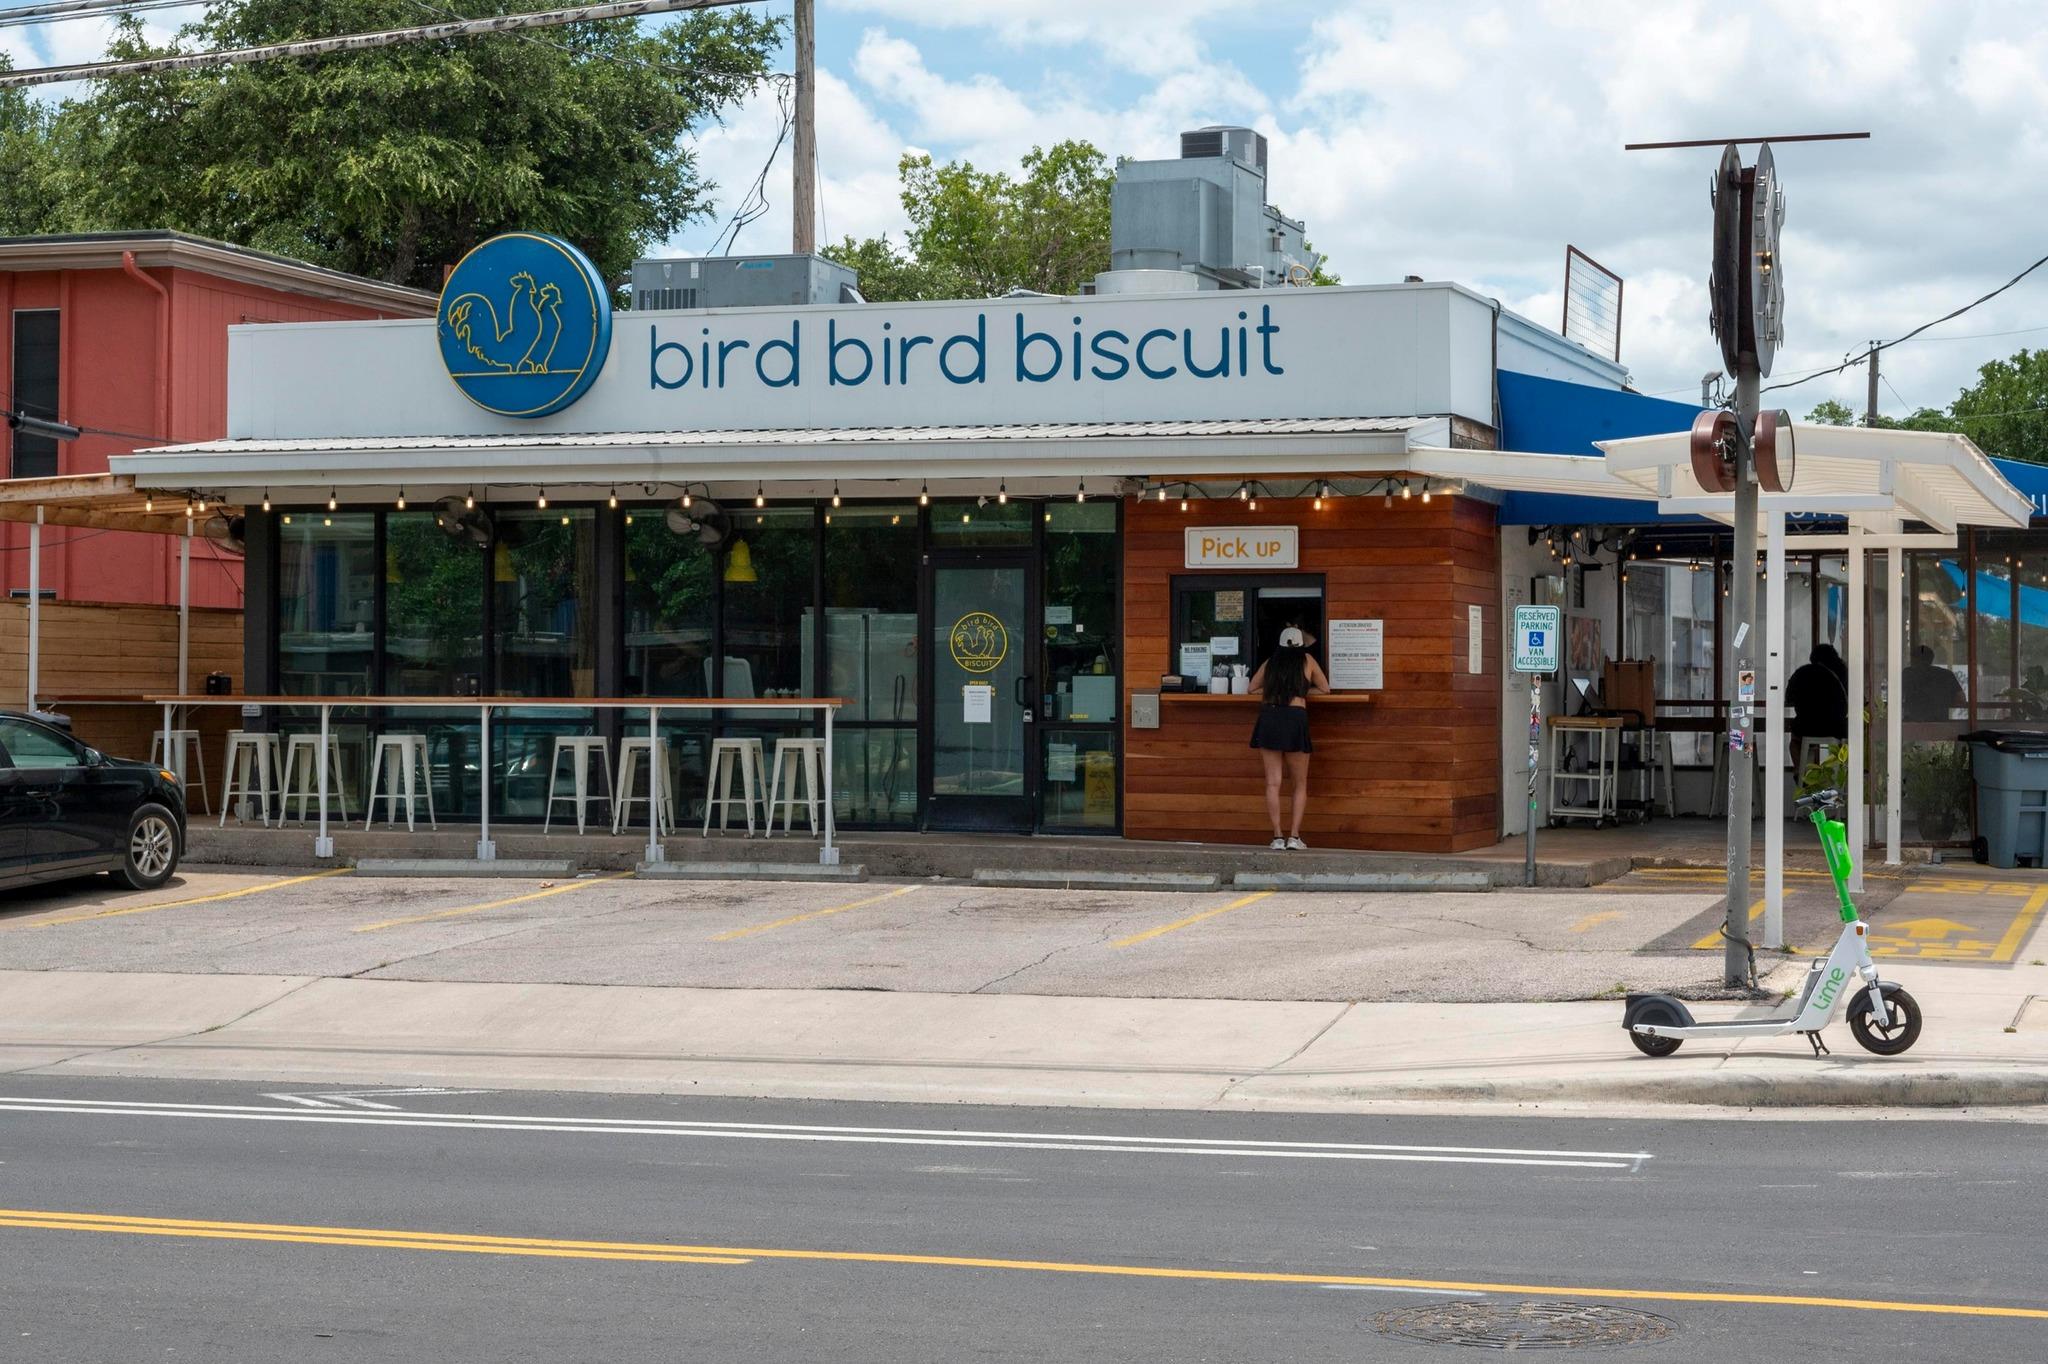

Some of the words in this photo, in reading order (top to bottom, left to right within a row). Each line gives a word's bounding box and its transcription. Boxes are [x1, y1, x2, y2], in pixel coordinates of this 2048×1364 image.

[650, 319, 800, 390] bird
[829, 313, 986, 386] bird
[1015, 304, 1285, 383] biscuit
[1201, 536, 1250, 558] Pick
[1518, 611, 1556, 621] RESERVED
[961, 617, 980, 630] bird
[983, 616, 998, 631] bird
[1520, 622, 1553, 630] PARKING
[1528, 648, 1544, 656] VAN
[1517, 656, 1554, 666] ACCESSIBLE
